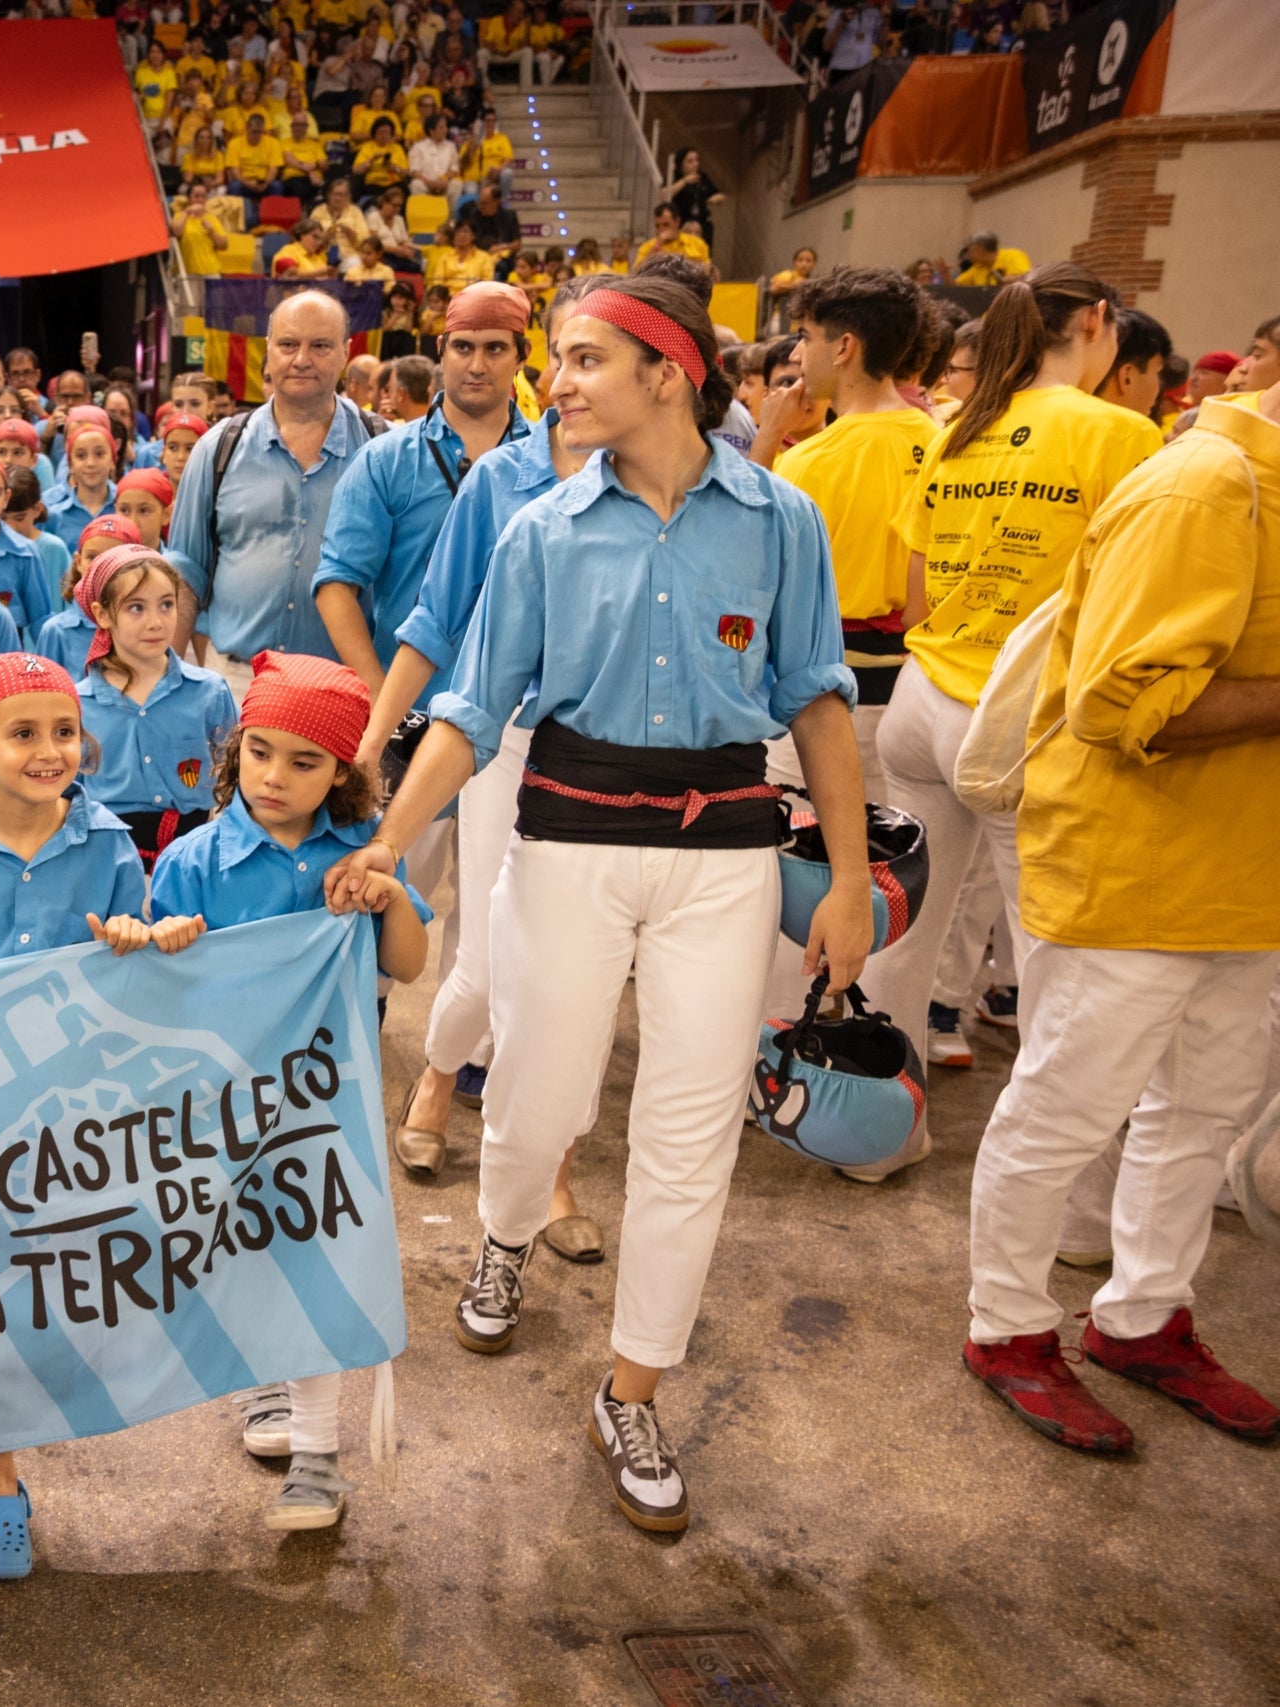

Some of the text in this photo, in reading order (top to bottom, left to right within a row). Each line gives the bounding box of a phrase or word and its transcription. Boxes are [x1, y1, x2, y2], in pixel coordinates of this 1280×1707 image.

[650, 53, 738, 64] repsol
[1036, 89, 1071, 134] tac
[1022, 482, 1080, 504] RIUS
[1001, 527, 1041, 541] Tarovi
[155, 1176, 215, 1225] DE
[10, 1147, 363, 1330] TERRASSA
